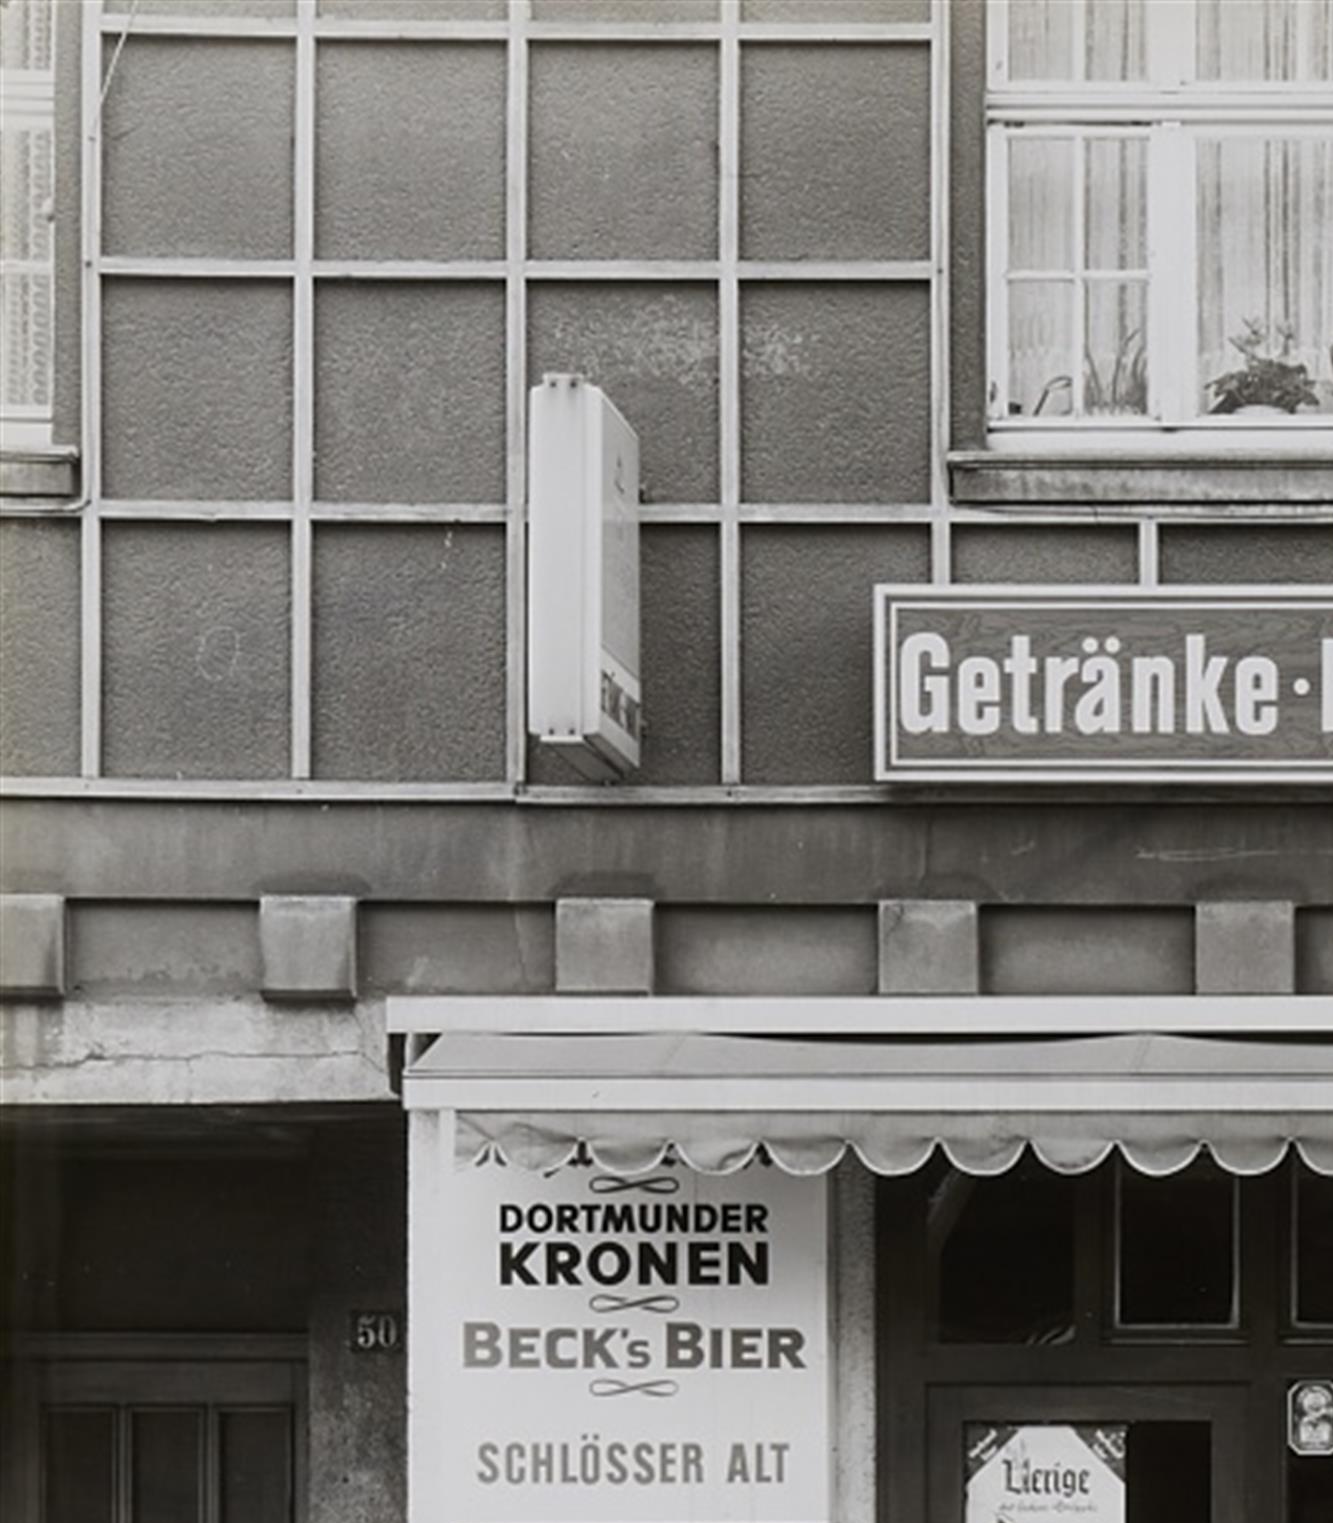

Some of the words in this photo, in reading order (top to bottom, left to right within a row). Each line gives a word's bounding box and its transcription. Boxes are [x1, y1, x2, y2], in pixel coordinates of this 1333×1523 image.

[499, 1202, 769, 1234] DORTMUNDER
[499, 1240, 770, 1287] KRONEN
[357, 1315, 398, 1349] 50
[664, 1321, 807, 1370] BIER
[476, 1432, 705, 1486] SCHLÖSSER
[725, 1442, 791, 1484] ALT
